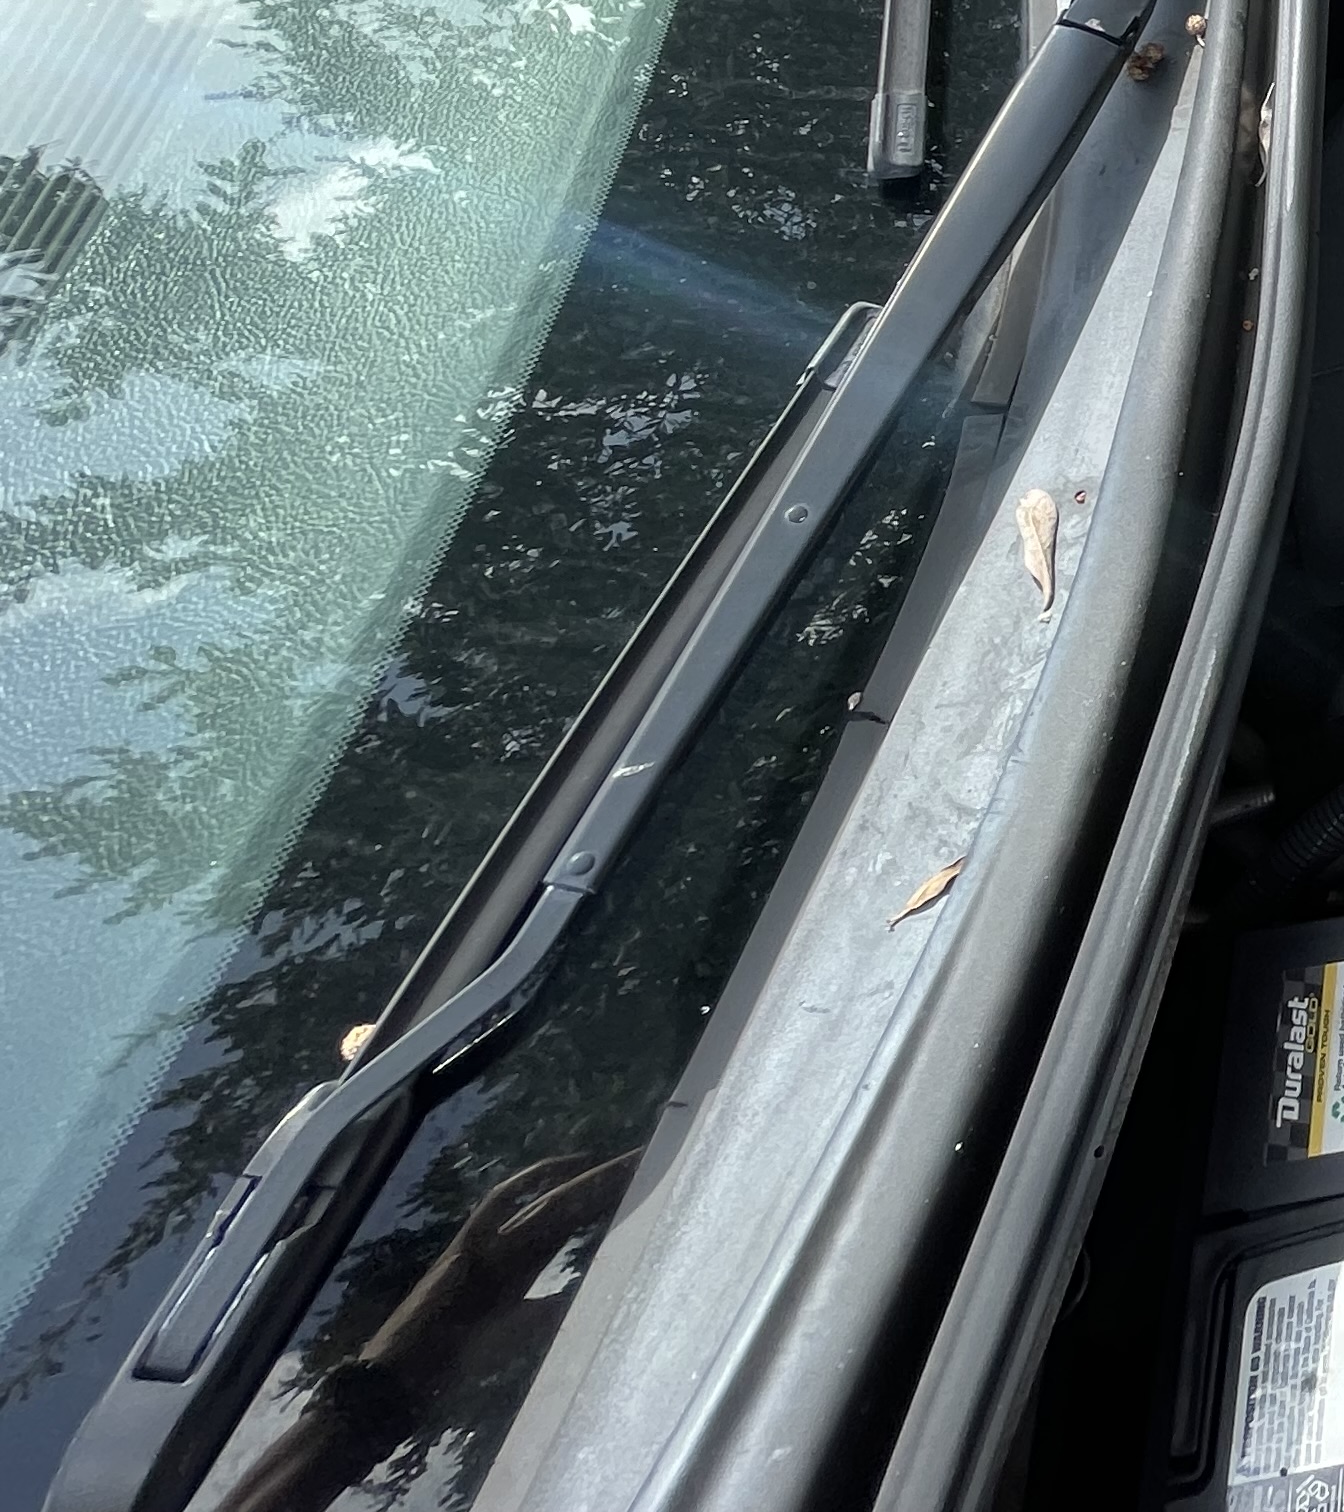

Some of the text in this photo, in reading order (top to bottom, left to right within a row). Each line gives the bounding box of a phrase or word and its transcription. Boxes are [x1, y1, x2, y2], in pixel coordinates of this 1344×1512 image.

[1276, 996, 1309, 1128] Duralast
[1304, 997, 1318, 1053] GOLD
[1316, 1009, 1331, 1103] PROVEN TOUGH
